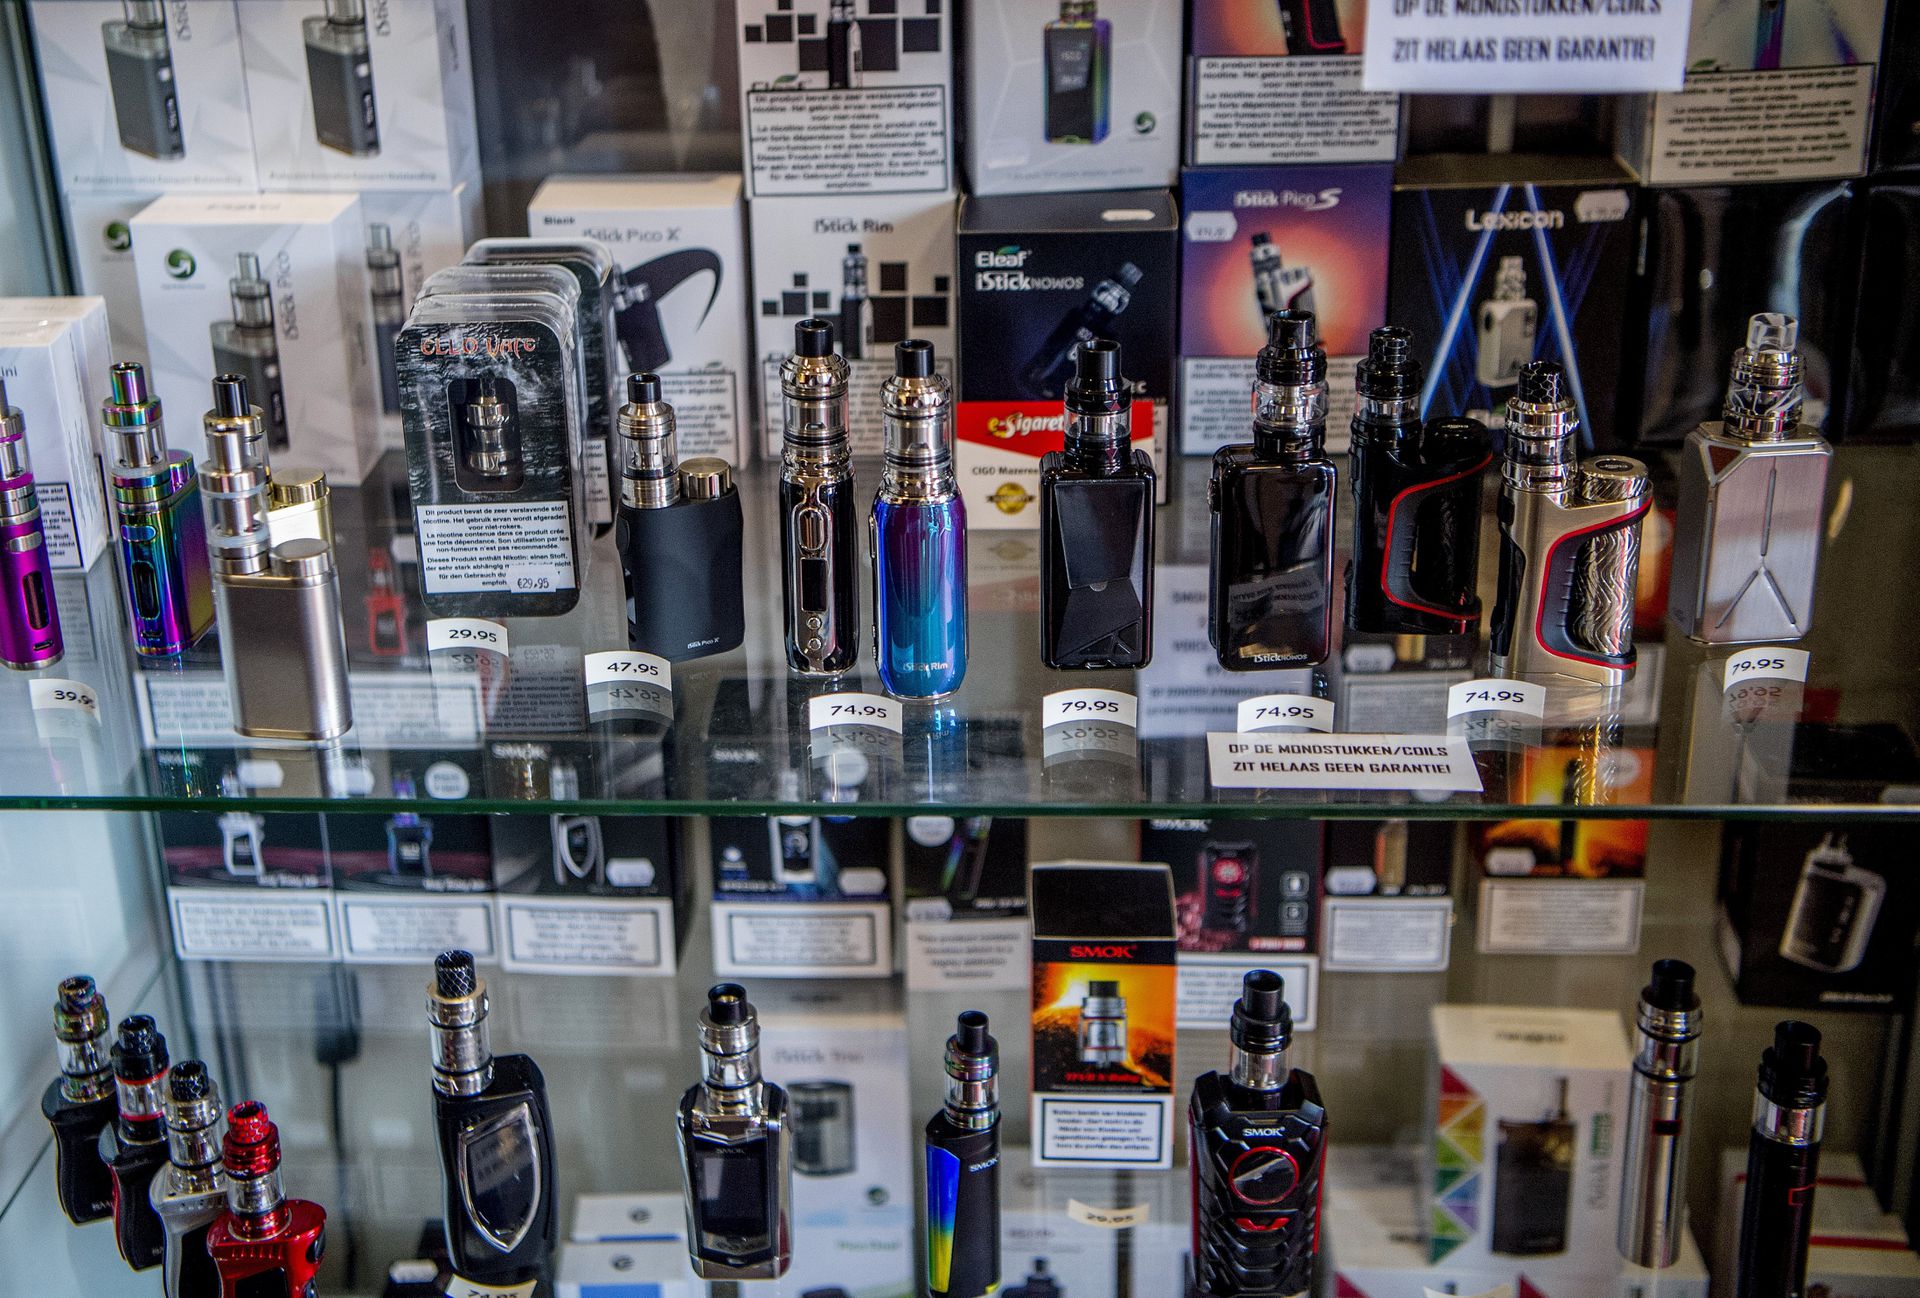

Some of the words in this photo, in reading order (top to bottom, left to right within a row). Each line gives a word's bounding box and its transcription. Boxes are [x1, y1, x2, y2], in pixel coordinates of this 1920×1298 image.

[1393, 36, 1418, 62] ZIT
[1425, 35, 1497, 62] HELAAS
[1502, 35, 1550, 61] GEEN
[1557, 35, 1655, 61] GARANTIE!
[864, 219, 894, 233] Rim
[1465, 208, 1565, 232] Lexicon
[627, 228, 662, 242] Pico
[667, 228, 680, 241] X
[975, 250, 1028, 268] Eleaf
[972, 466, 996, 476] CIGO
[999, 466, 1039, 475] Mazeree
[466, 517, 491, 525] gebruik
[455, 537, 496, 546] dépendance.
[473, 563, 503, 571] abhängig
[449, 628, 497, 643] 29,95
[607, 661, 659, 676] 47,95
[930, 662, 948, 671] Rim
[830, 704, 888, 718] 74,95
[1255, 706, 1315, 719] 74,95
[1229, 744, 1249, 753] OP
[1255, 745, 1273, 754] DE
[1279, 745, 1448, 757] MONDSTUKKEN/COILS
[1233, 762, 1255, 771] ZIT
[1261, 762, 1320, 772] HELAAS
[1325, 762, 1365, 773] GEEN
[1070, 945, 1134, 959] SMOK
[1243, 1127, 1284, 1137] SMOK
[969, 1157, 998, 1173] SMOK
